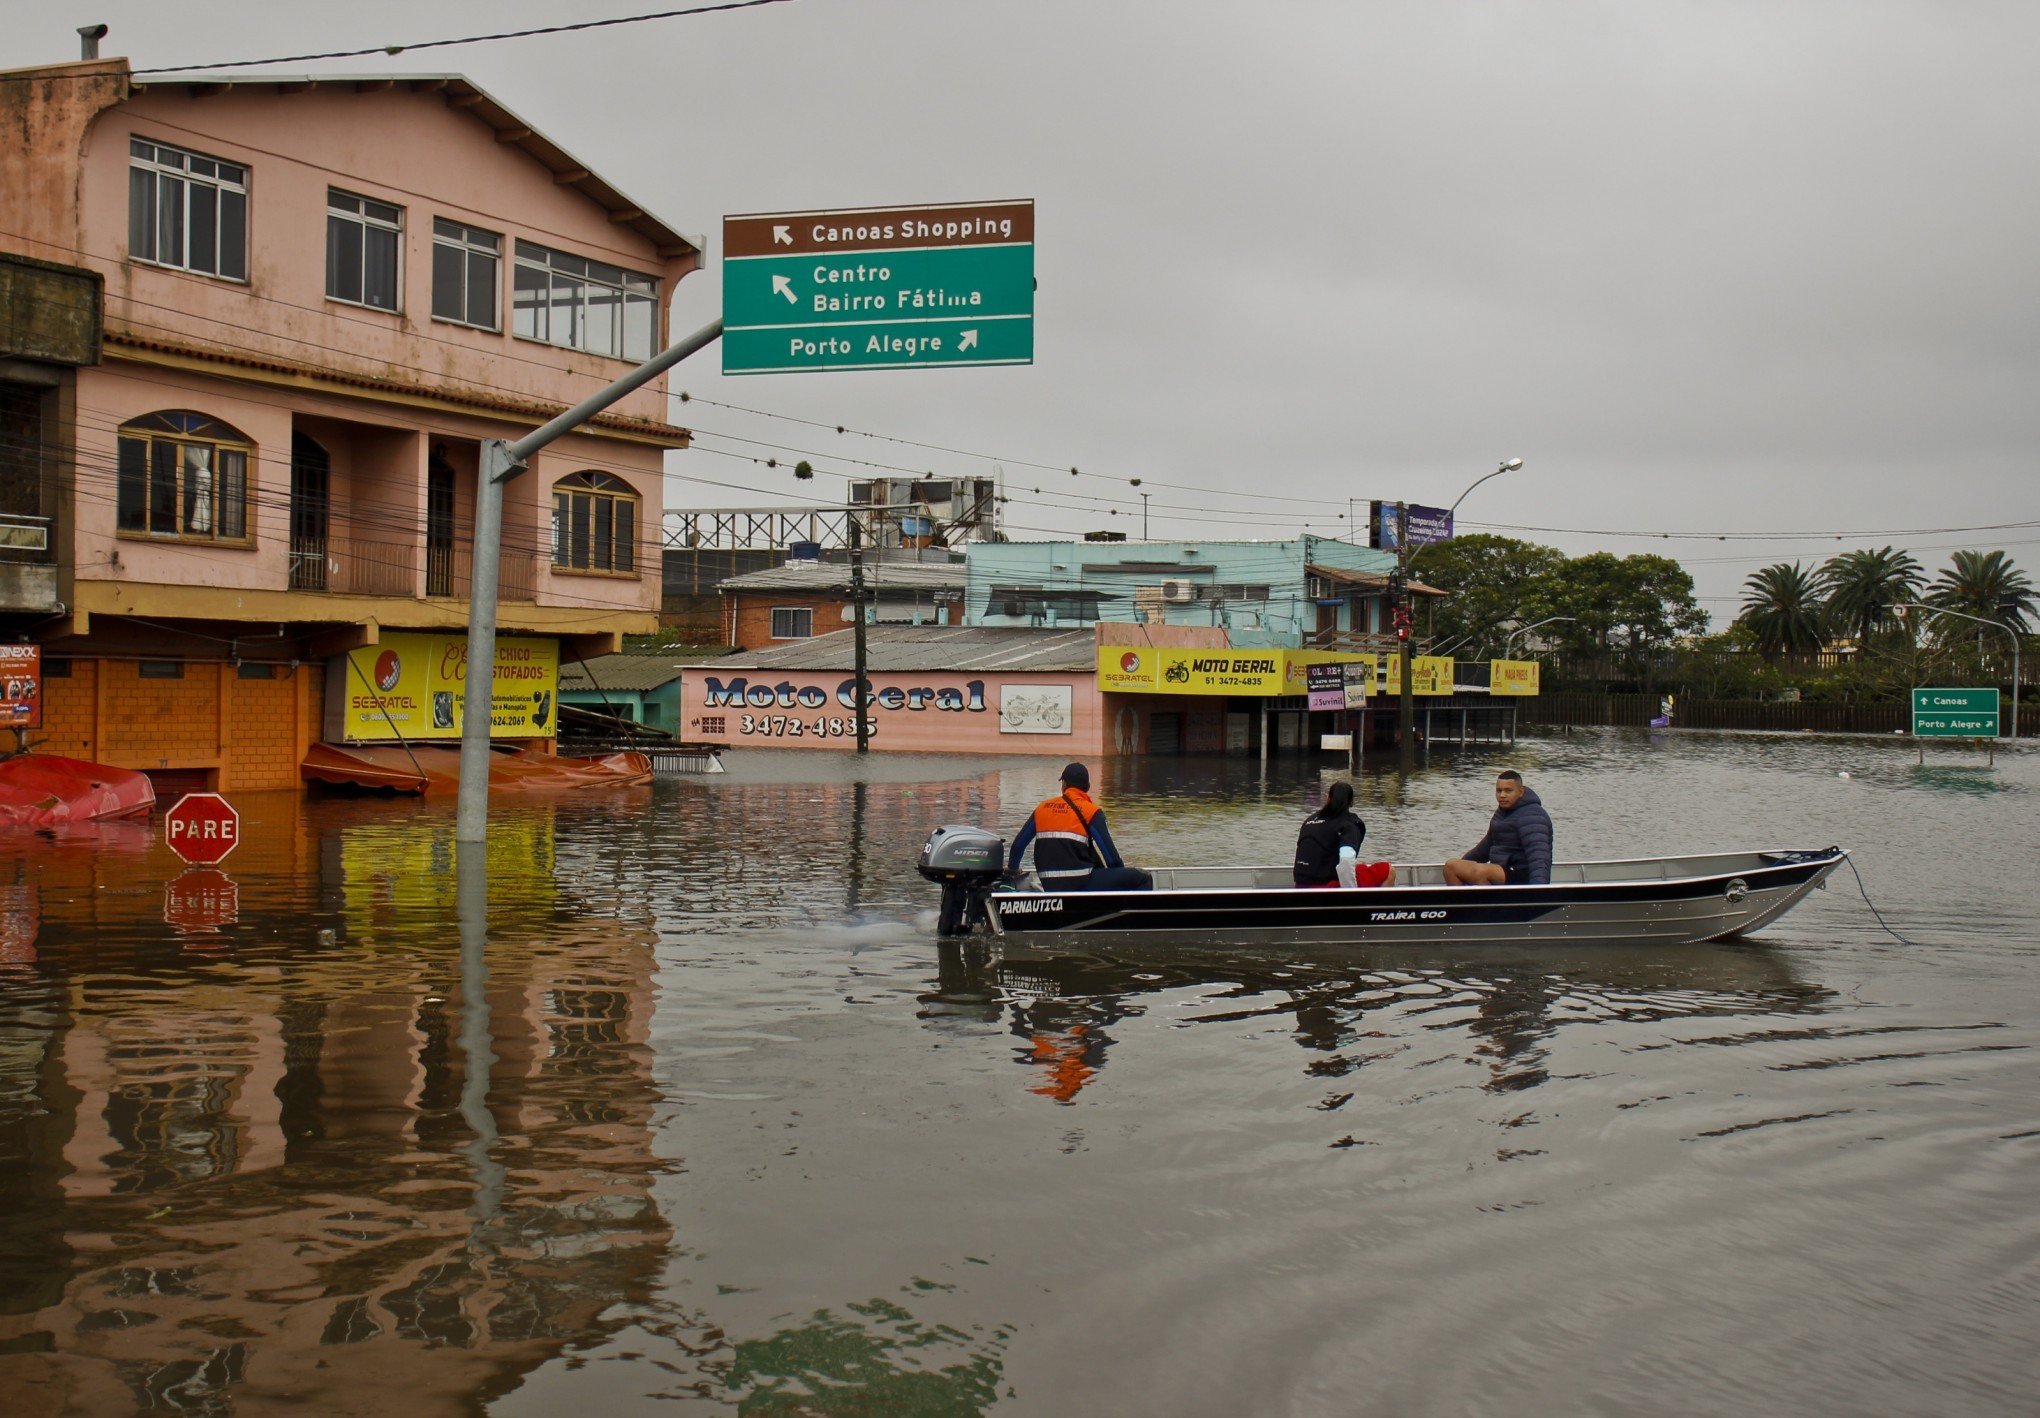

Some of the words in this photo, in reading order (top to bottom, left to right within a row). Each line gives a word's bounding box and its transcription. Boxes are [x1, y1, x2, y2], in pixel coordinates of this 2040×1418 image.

[812, 224, 894, 242] Canoas
[901, 218, 1012, 239] Shopping
[813, 265, 891, 283] Centro
[813, 294, 886, 312] Bairro
[790, 337, 851, 356] Porto
[866, 334, 942, 357] Alegre
[500, 648, 530, 661] CHICO
[1192, 659, 1229, 673] MOTO
[1232, 659, 1276, 674] GERAL
[1205, 677, 1215, 685] 51
[1219, 677, 1262, 686] 3472-4835
[704, 677, 827, 709] Moto
[836, 678, 986, 712] Geral
[1318, 697, 1344, 706] Suvinil
[1933, 697, 1968, 705] Canoas
[1918, 720, 1945, 728] Porto
[1950, 720, 1981, 729] Alegre
[171, 820, 234, 839] PARE
[999, 898, 1064, 914] PARNAUTICA
[1420, 910, 1447, 920] 600
